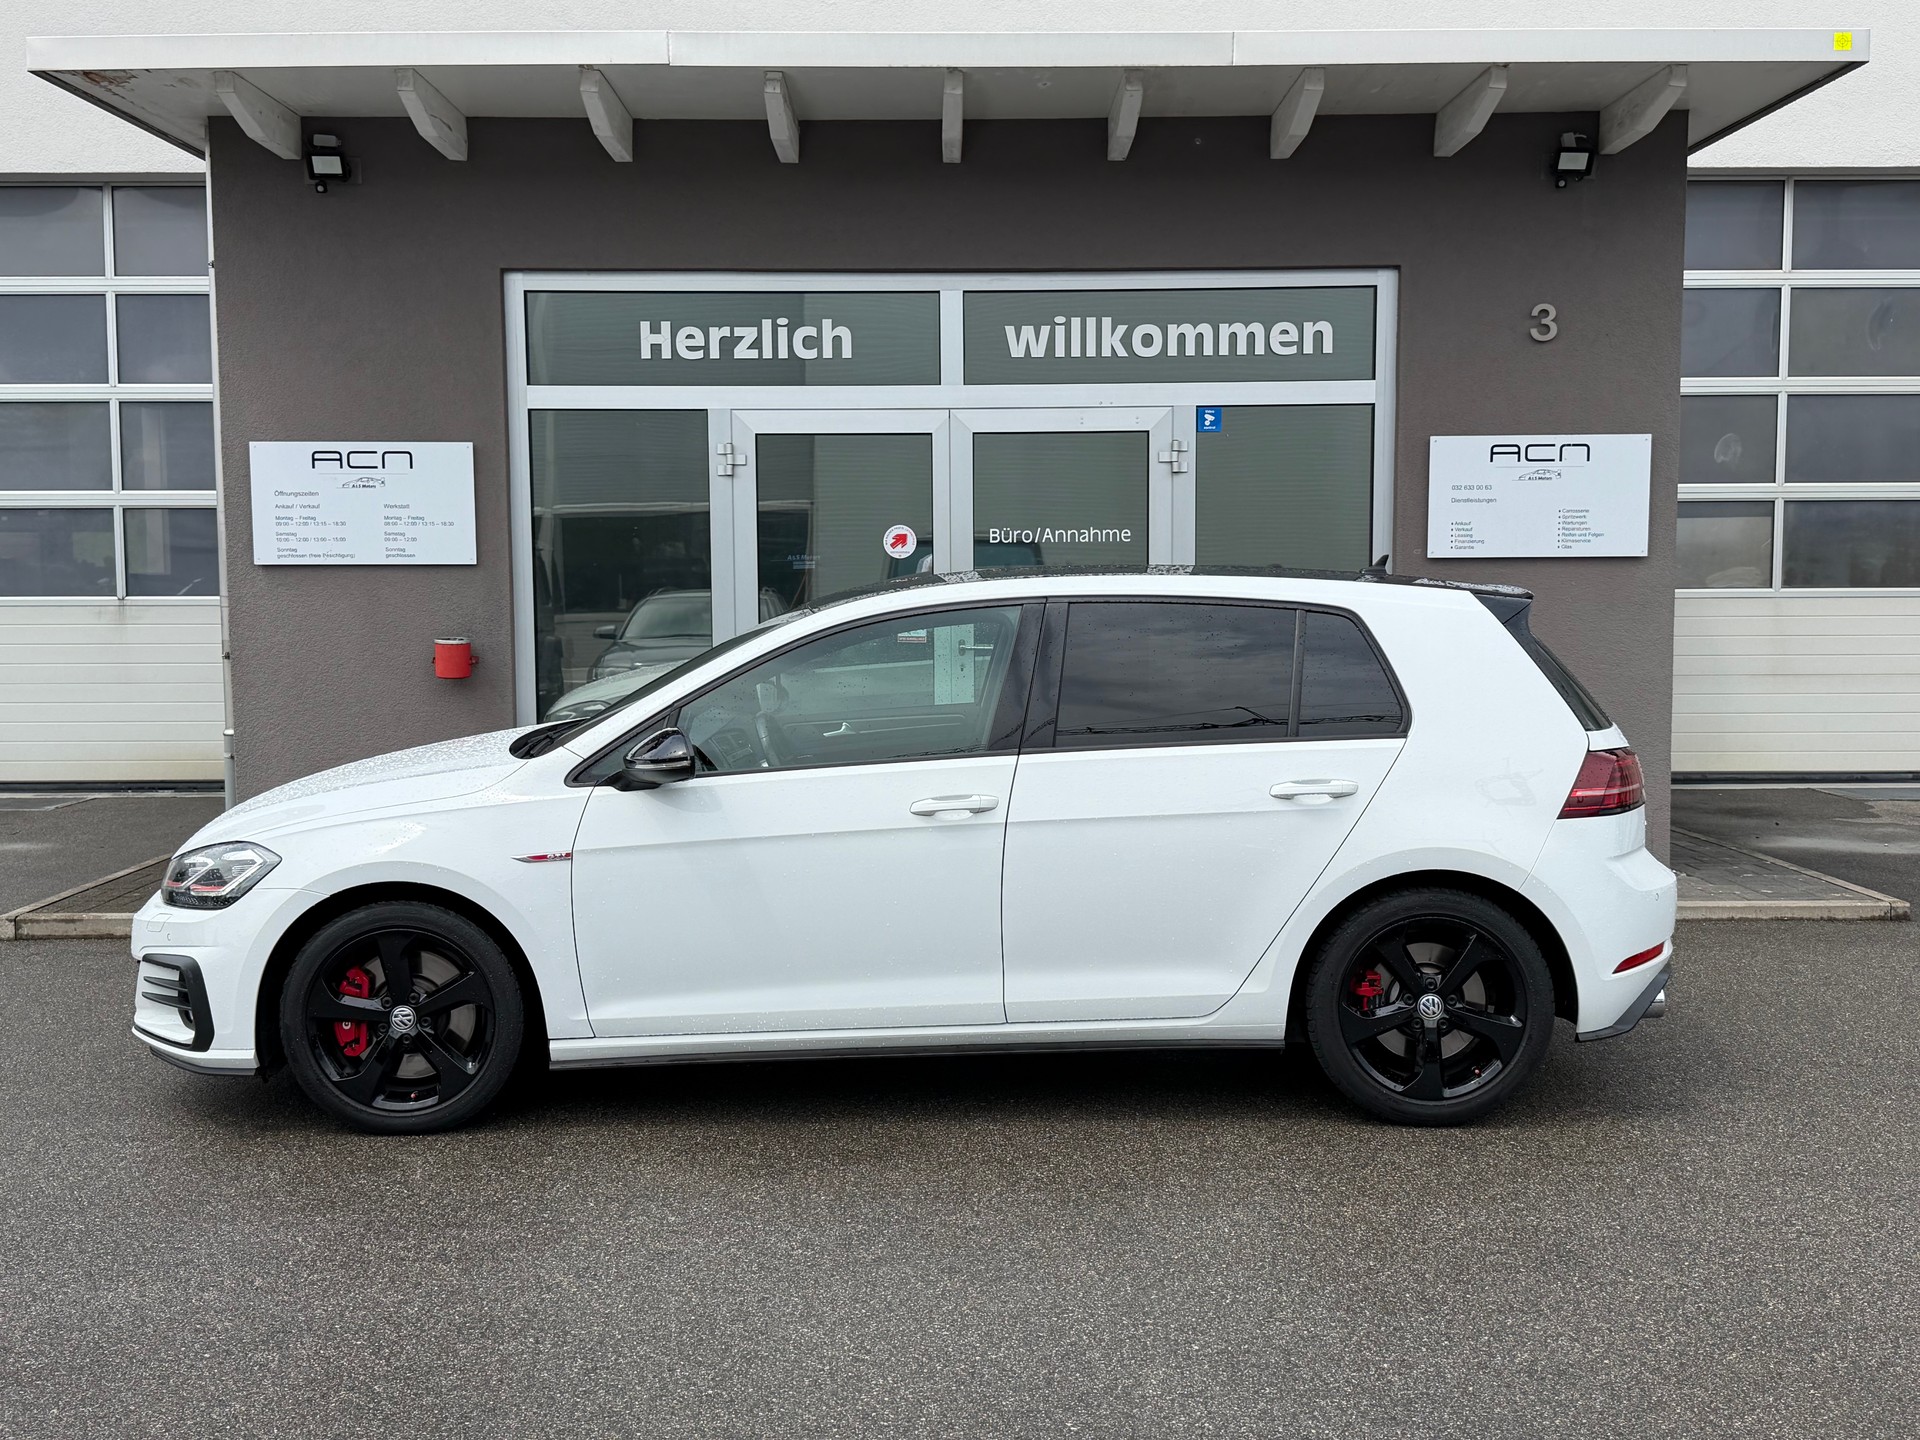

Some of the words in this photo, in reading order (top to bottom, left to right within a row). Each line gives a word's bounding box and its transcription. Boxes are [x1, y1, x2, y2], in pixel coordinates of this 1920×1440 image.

[640, 319, 853, 360] Herzlich
[1005, 316, 1335, 356] willkommen
[1530, 303, 1558, 342] 3
[988, 524, 1132, 546] Büro/Annahme
